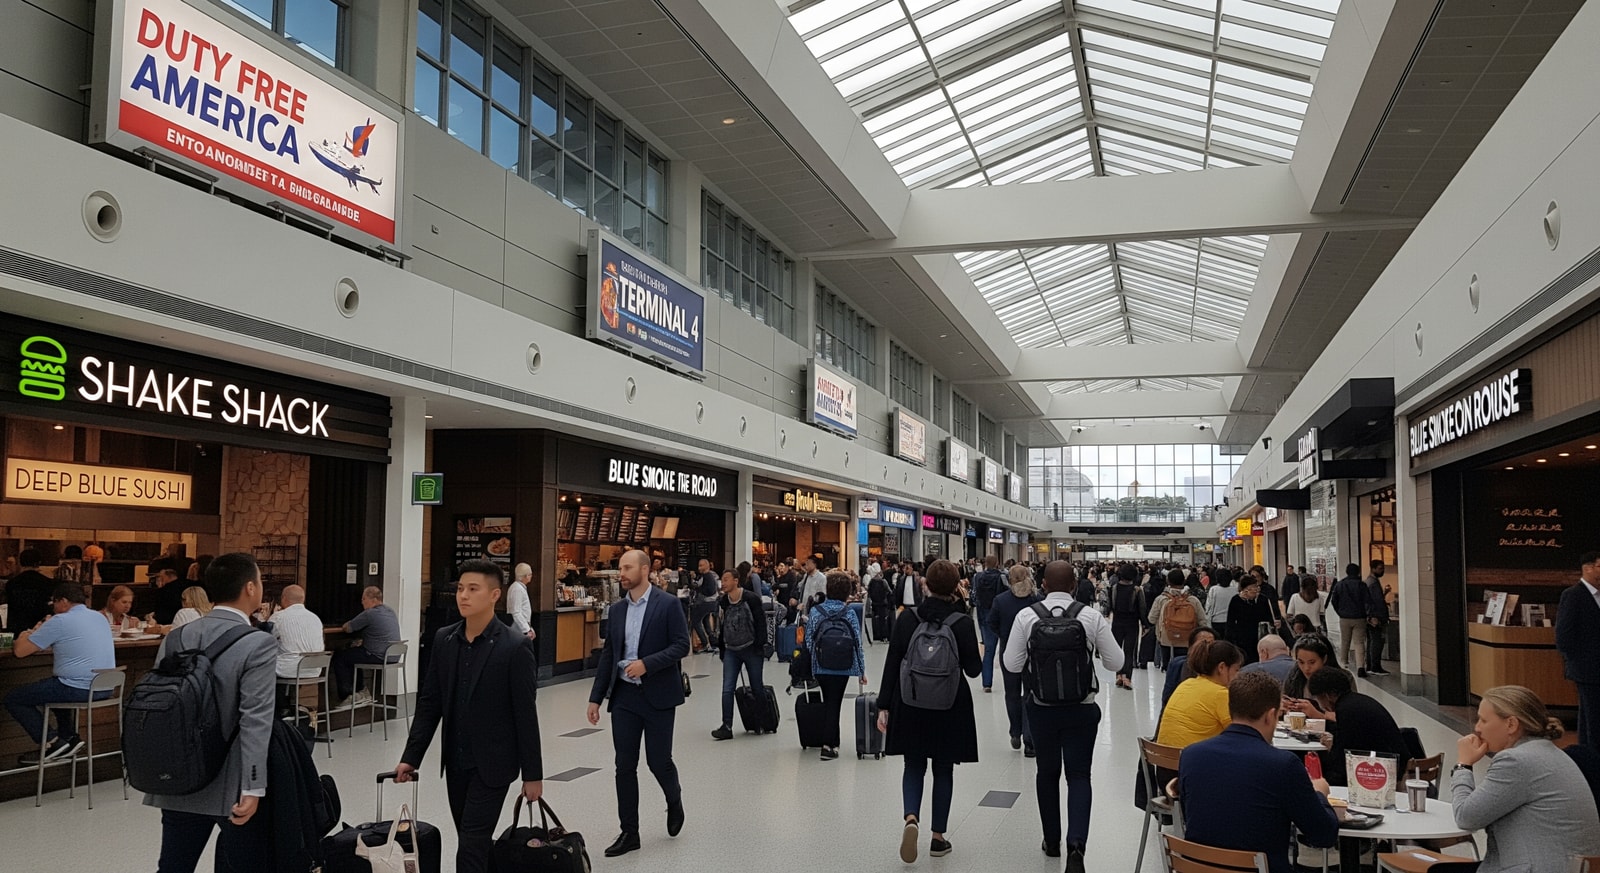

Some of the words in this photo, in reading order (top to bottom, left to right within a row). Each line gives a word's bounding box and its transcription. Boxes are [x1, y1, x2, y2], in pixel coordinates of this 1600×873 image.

[137, 8, 232, 83] DUTY
[236, 60, 308, 125] FREE
[130, 53, 301, 165] AMERICA
[619, 275, 689, 339] TERMINAL
[690, 315, 699, 343] 4
[78, 355, 213, 420] SHAKE
[220, 383, 330, 438] SHACK
[1410, 419, 1429, 457] BLUE
[15, 467, 72, 494] DEEP
[78, 473, 128, 498] BLUE
[132, 478, 185, 502] SUSHI
[608, 458, 640, 486] BLUE
[641, 464, 675, 492] SMOKE
[677, 472, 690, 494] THE
[691, 474, 717, 497] ROAD
